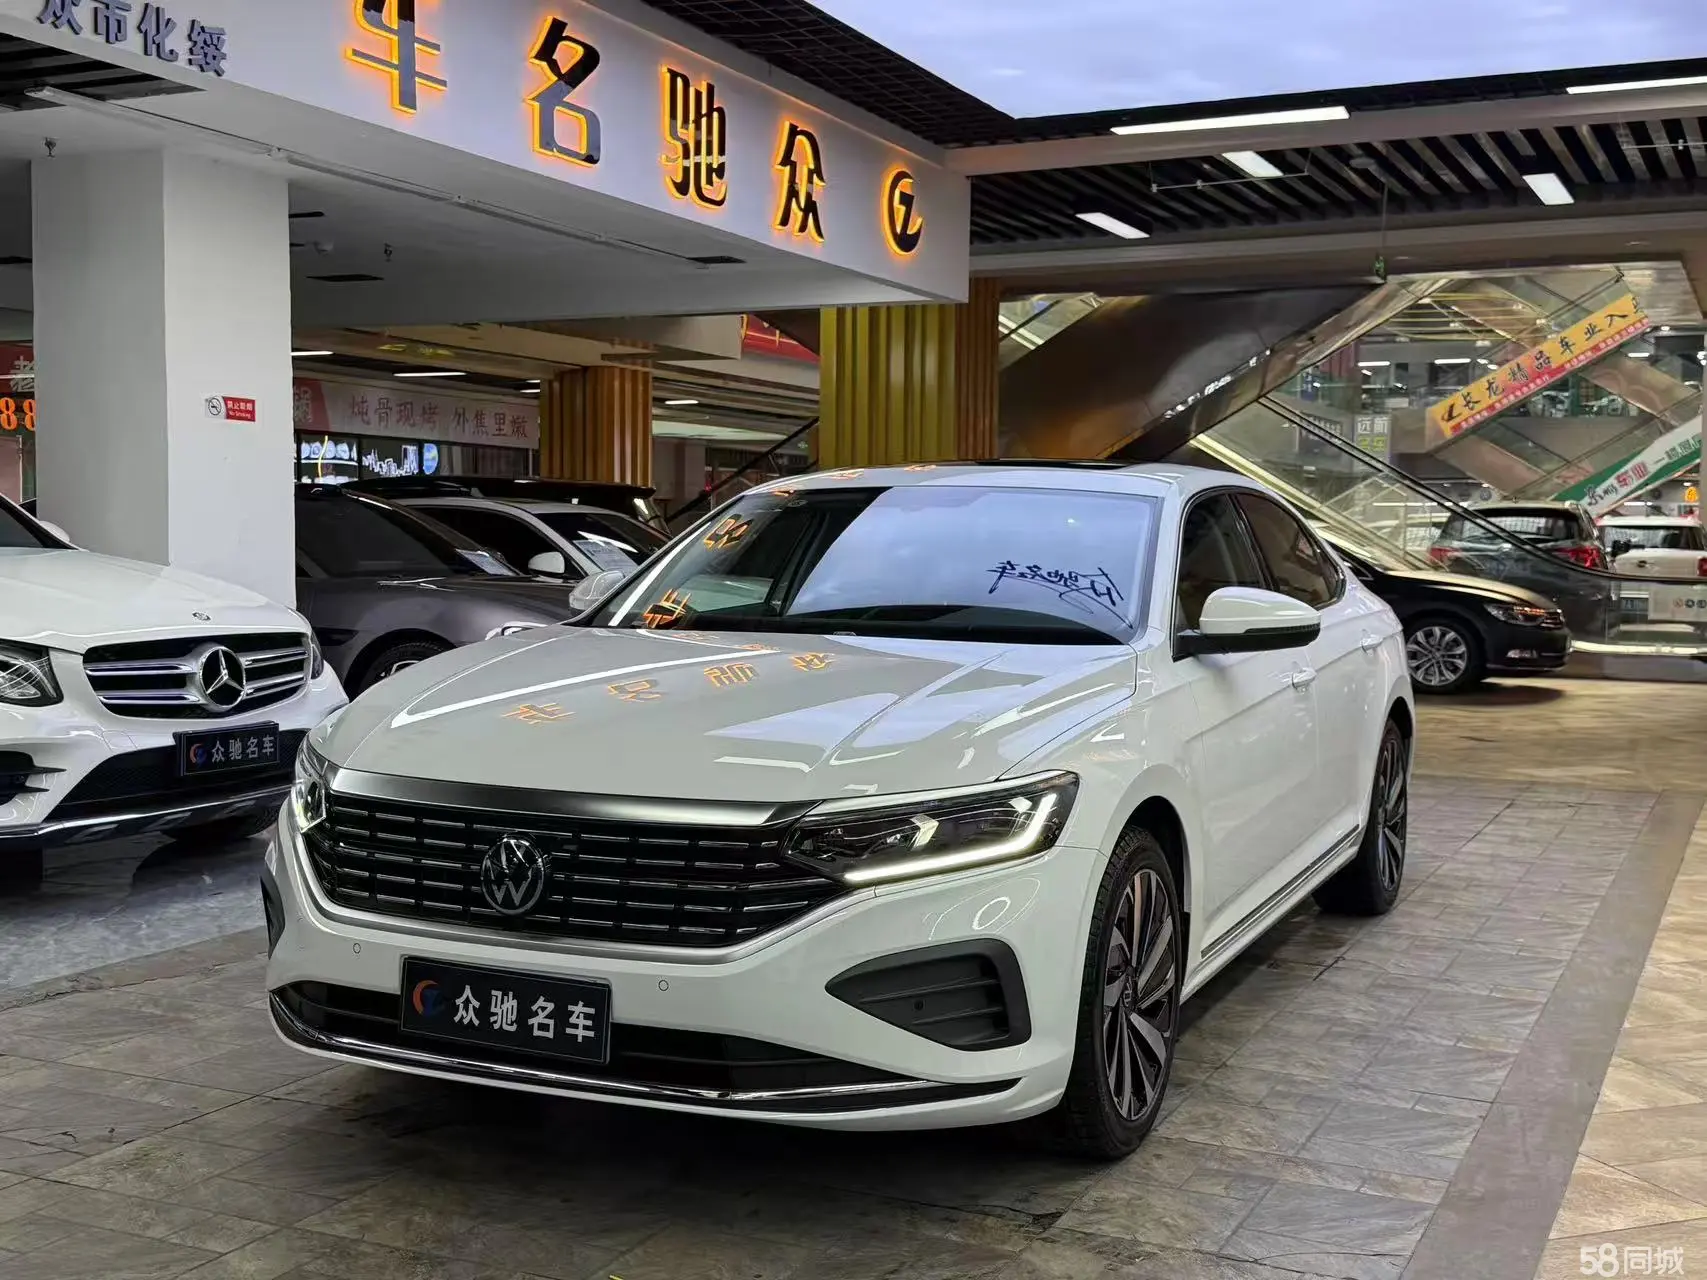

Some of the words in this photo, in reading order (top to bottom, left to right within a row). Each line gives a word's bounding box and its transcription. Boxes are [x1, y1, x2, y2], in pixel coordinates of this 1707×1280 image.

[211, 735, 275, 763] 众驰名车
[453, 984, 596, 1043] 众驰名车
